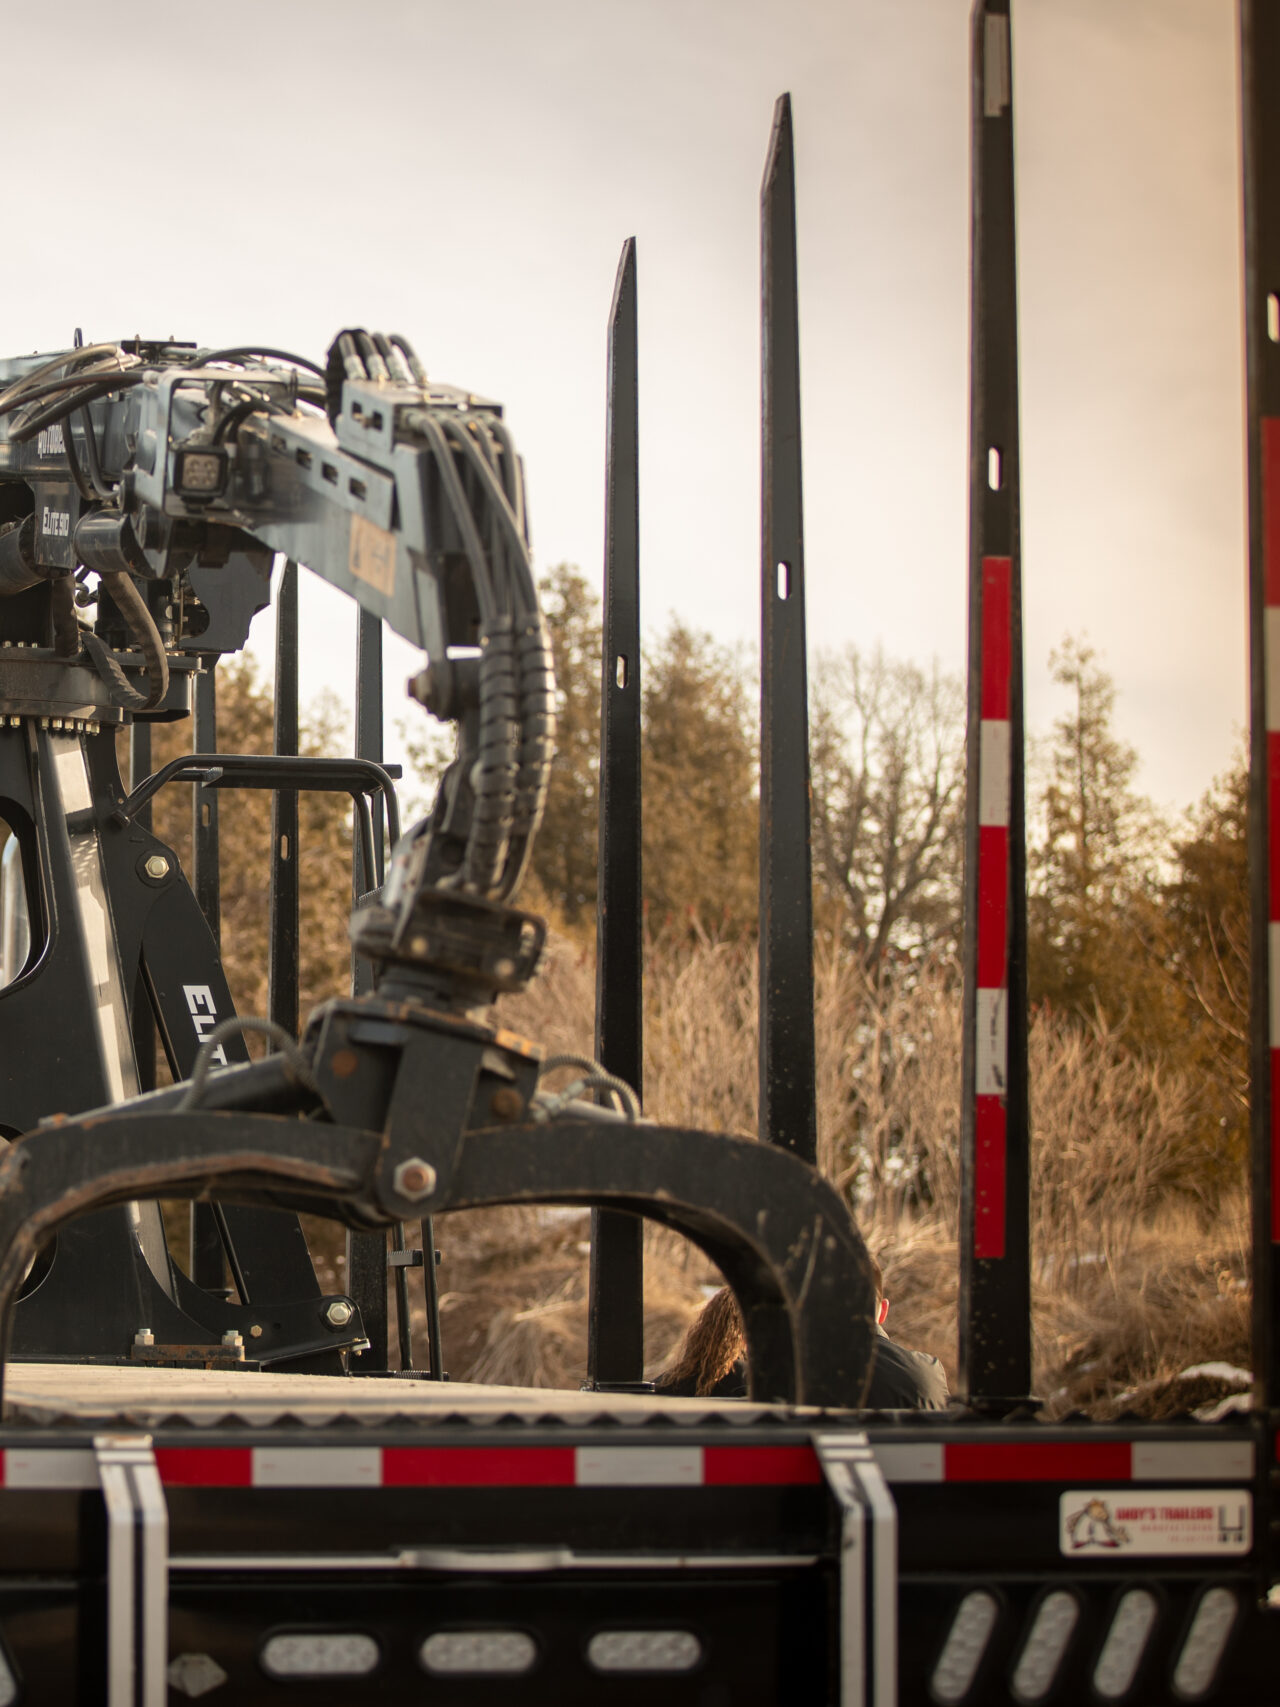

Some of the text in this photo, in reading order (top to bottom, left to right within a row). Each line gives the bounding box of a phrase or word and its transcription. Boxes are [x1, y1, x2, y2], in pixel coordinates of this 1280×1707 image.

[182, 985, 228, 1070] ELIT
[1116, 1507, 1214, 1520] ANDY'S TRAILERS
